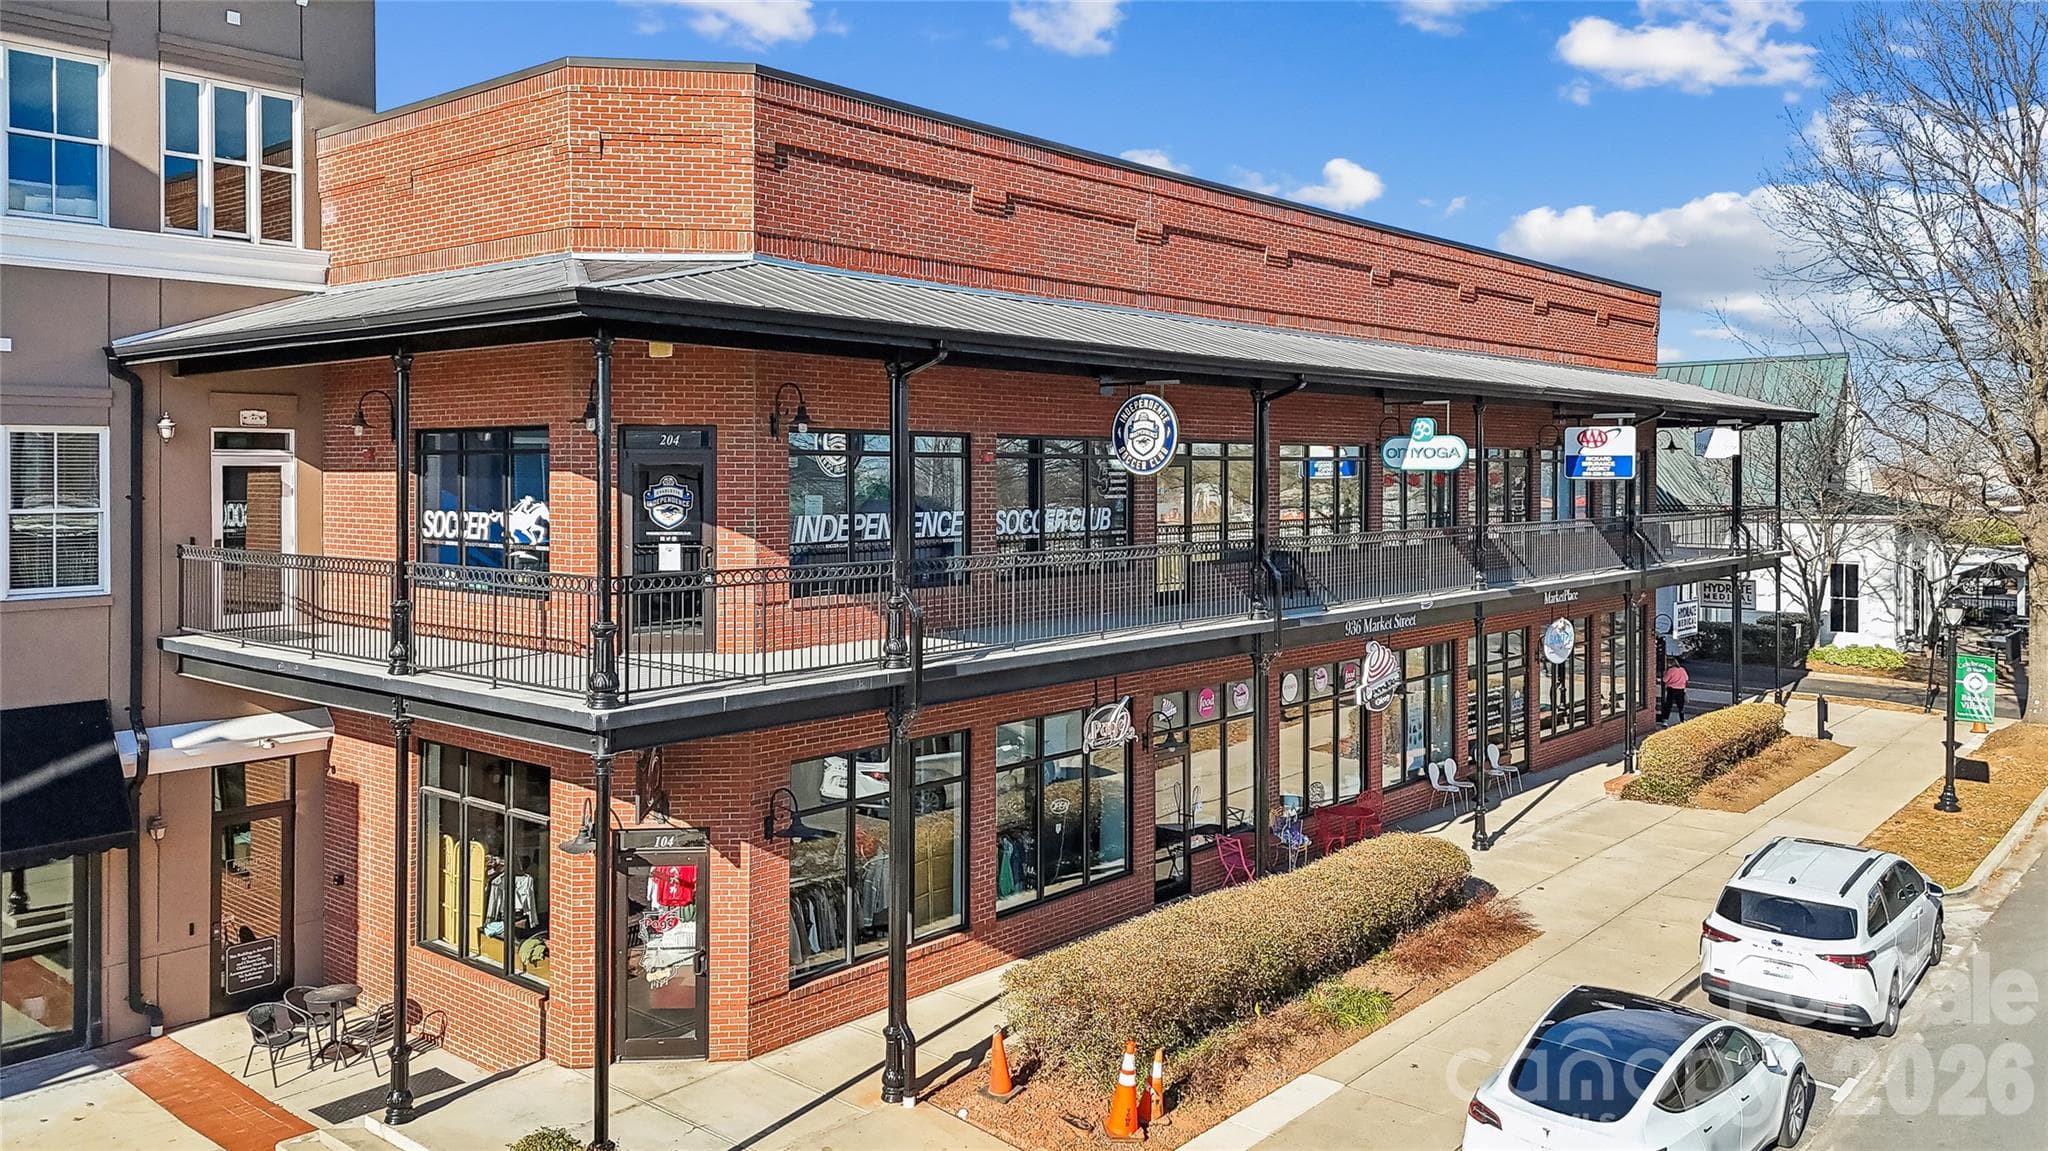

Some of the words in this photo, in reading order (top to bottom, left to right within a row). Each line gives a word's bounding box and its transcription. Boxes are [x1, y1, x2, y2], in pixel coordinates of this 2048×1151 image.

[1119, 399, 1170, 424] INDEPENDENCE
[660, 434, 681, 446] 204
[1579, 430, 1605, 447] AAA
[1119, 446, 1147, 470] SOCCER
[1149, 447, 1169, 468] CLUB
[793, 511, 965, 543] INDEPENENCE
[996, 509, 1069, 535] SOCCER
[1069, 507, 1112, 531] CLUB
[1703, 583, 1752, 594] HYDRTE
[1703, 593, 1752, 602] MEDIL
[1345, 619, 1362, 636] 936
[1363, 616, 1393, 633] Market
[1393, 613, 1417, 629] Street
[654, 836, 675, 847] 104
